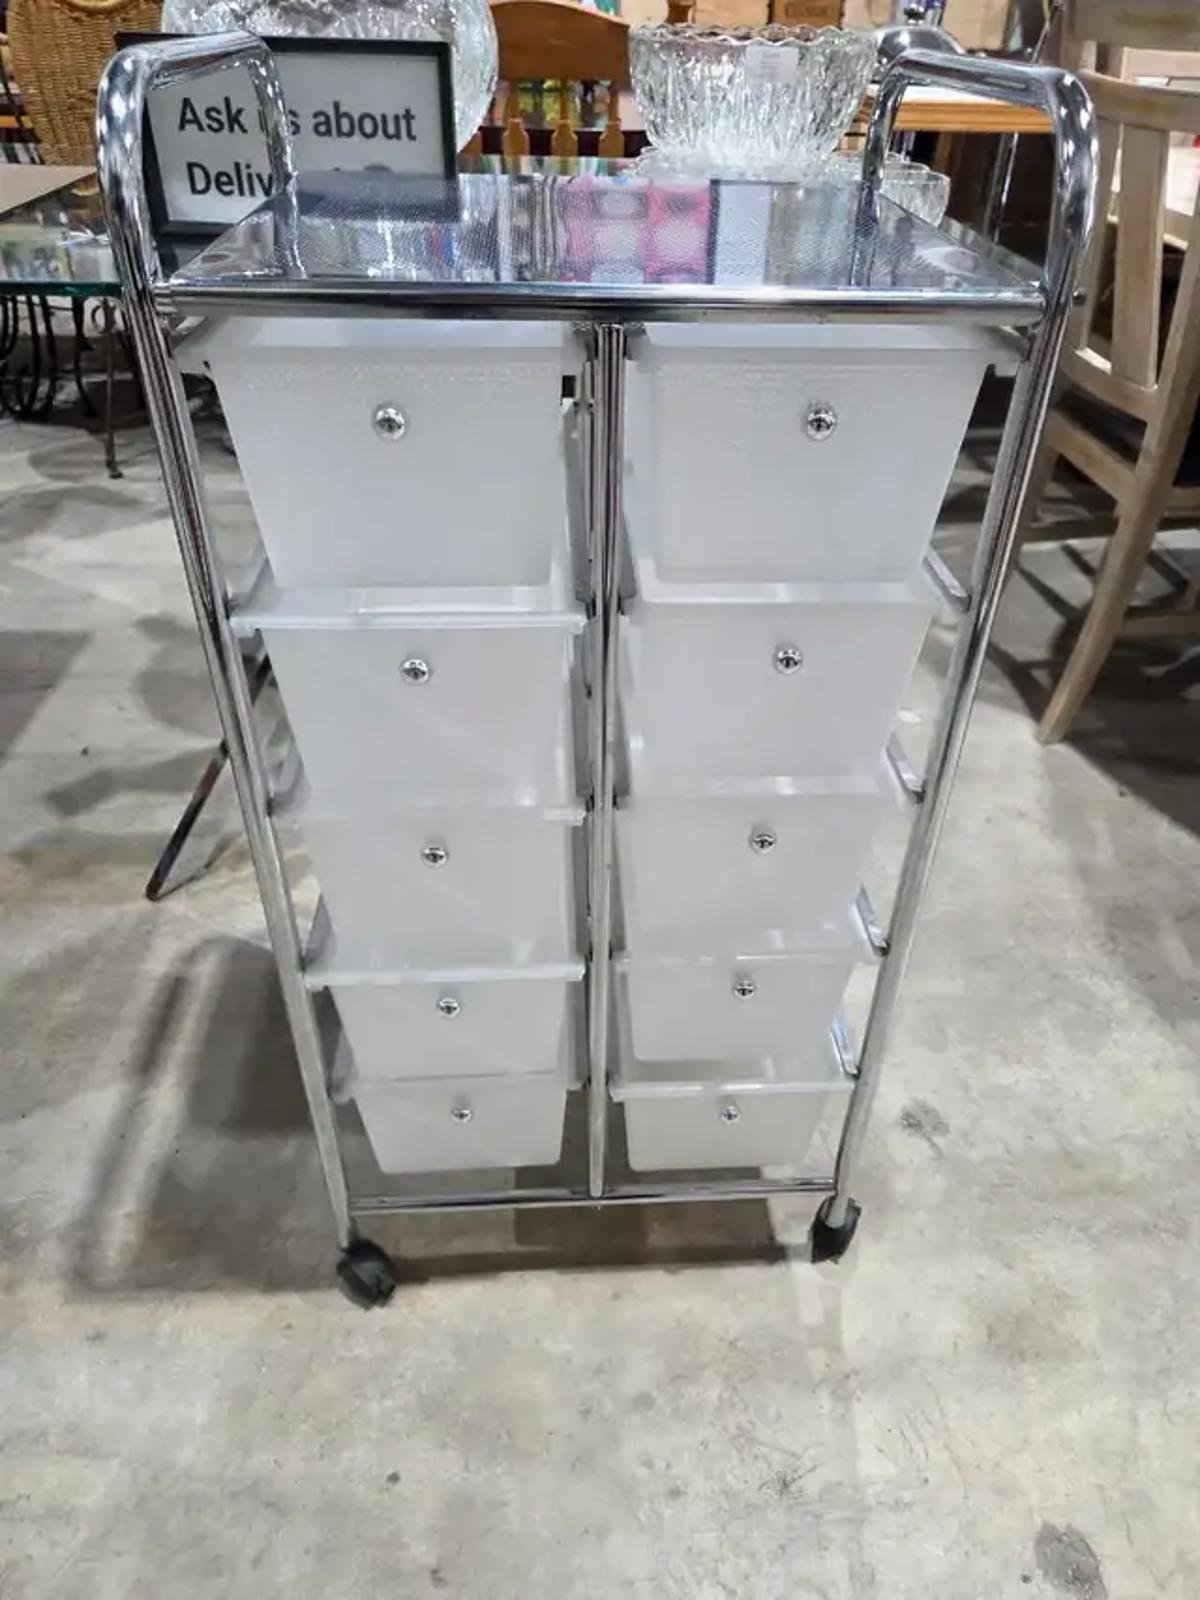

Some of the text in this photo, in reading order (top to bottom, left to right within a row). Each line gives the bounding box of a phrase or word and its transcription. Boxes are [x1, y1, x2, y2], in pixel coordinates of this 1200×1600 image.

[178, 96, 417, 141] Ask s about
[186, 161, 273, 198] Deliv
